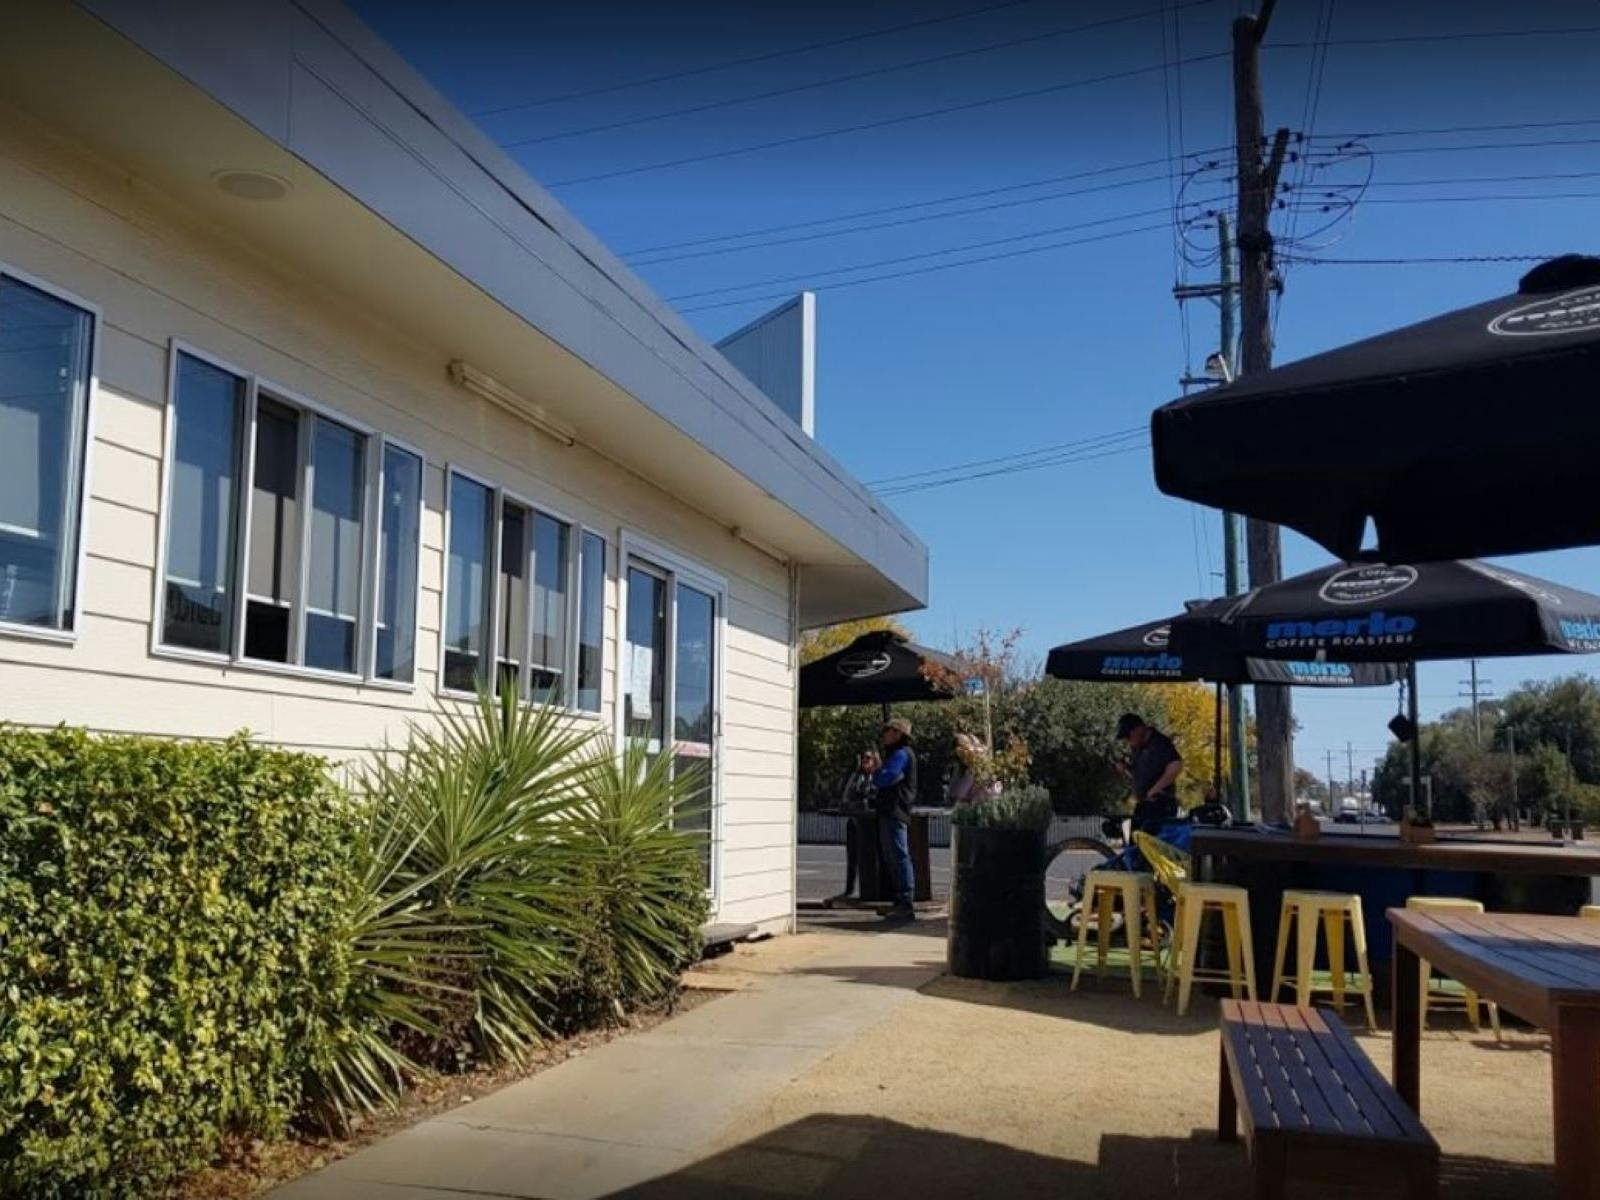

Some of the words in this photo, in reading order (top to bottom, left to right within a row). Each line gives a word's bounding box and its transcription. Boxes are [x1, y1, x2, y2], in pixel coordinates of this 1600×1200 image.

[1266, 611, 1417, 639] merlo
[1265, 637, 1326, 649] COFFEE
[1331, 633, 1413, 647] ROASTERS
[1103, 652, 1182, 670] merlo
